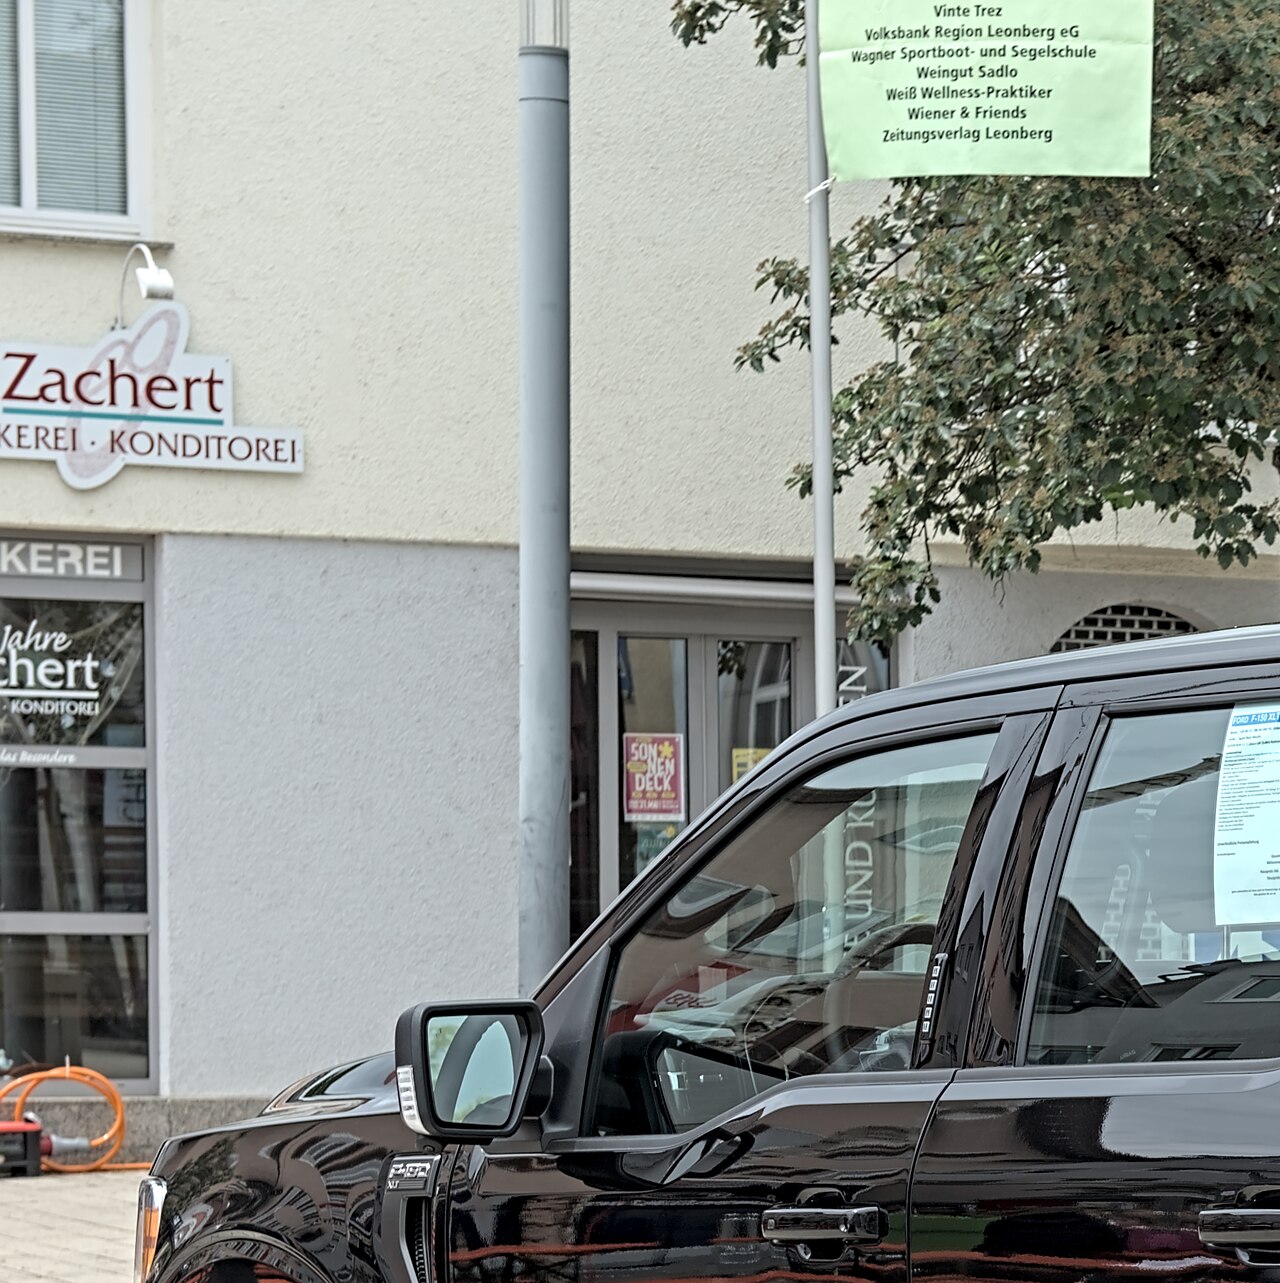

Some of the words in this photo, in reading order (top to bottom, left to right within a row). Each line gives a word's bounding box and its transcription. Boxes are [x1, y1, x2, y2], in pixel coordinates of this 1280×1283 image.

[934, 5, 969, 17] Vinte
[975, 5, 1002, 16] Trez
[866, 26, 929, 40] Volksbank
[936, 25, 982, 41] Region
[988, 25, 1055, 40] Leonberg
[1061, 26, 1078, 37] eG
[852, 51, 895, 64] Wagner
[901, 46, 974, 61] Sportboot-
[981, 45, 1006, 57] und
[1012, 45, 1096, 61] Segelschule
[917, 66, 973, 81] Weingut
[979, 65, 1017, 77] Sadlo
[887, 87, 916, 100] Weiß
[921, 86, 1052, 98] Wellness-Praktiker
[908, 107, 955, 119] Wiener
[961, 107, 969, 118] &
[976, 106, 1026, 118] Friends
[883, 127, 980, 143] Zeitungsverlag
[986, 127, 1052, 142] Leonberg
[2, 353, 223, 412] Zachert
[110, 430, 297, 463] KONDITOREI
[1, 619, 72, 652] Jahre
[11, 699, 99, 716] KONDITOREI
[1233, 715, 1249, 725] FORD
[1251, 713, 1268, 723] F-150
[631, 743, 658, 761] SON
[635, 774, 672, 792] DECK
[845, 841, 874, 920] UND
